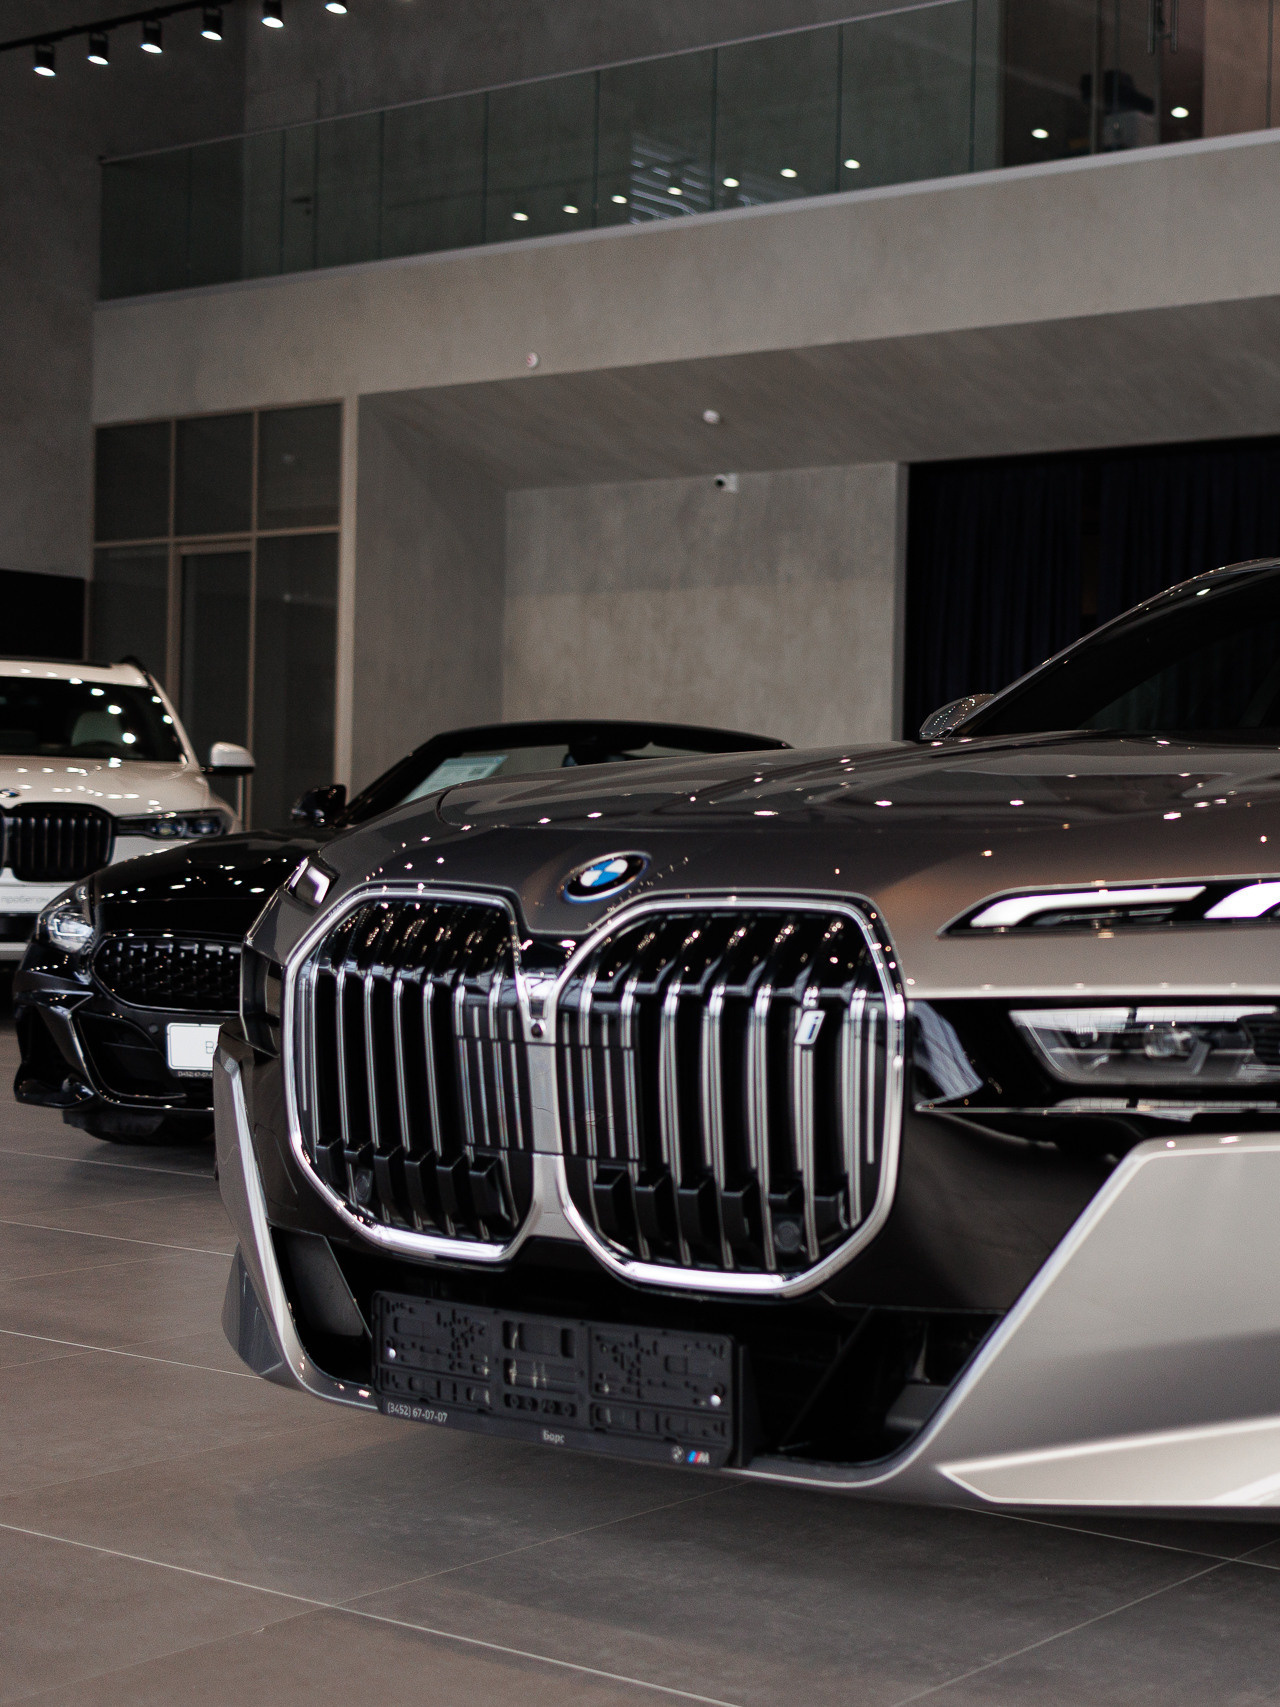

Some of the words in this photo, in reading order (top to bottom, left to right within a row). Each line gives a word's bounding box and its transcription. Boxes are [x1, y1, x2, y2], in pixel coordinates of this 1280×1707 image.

[205, 1040, 215, 1055] B
[387, 1402, 411, 1418] (3452)
[412, 1407, 448, 1423] 67-07-07
